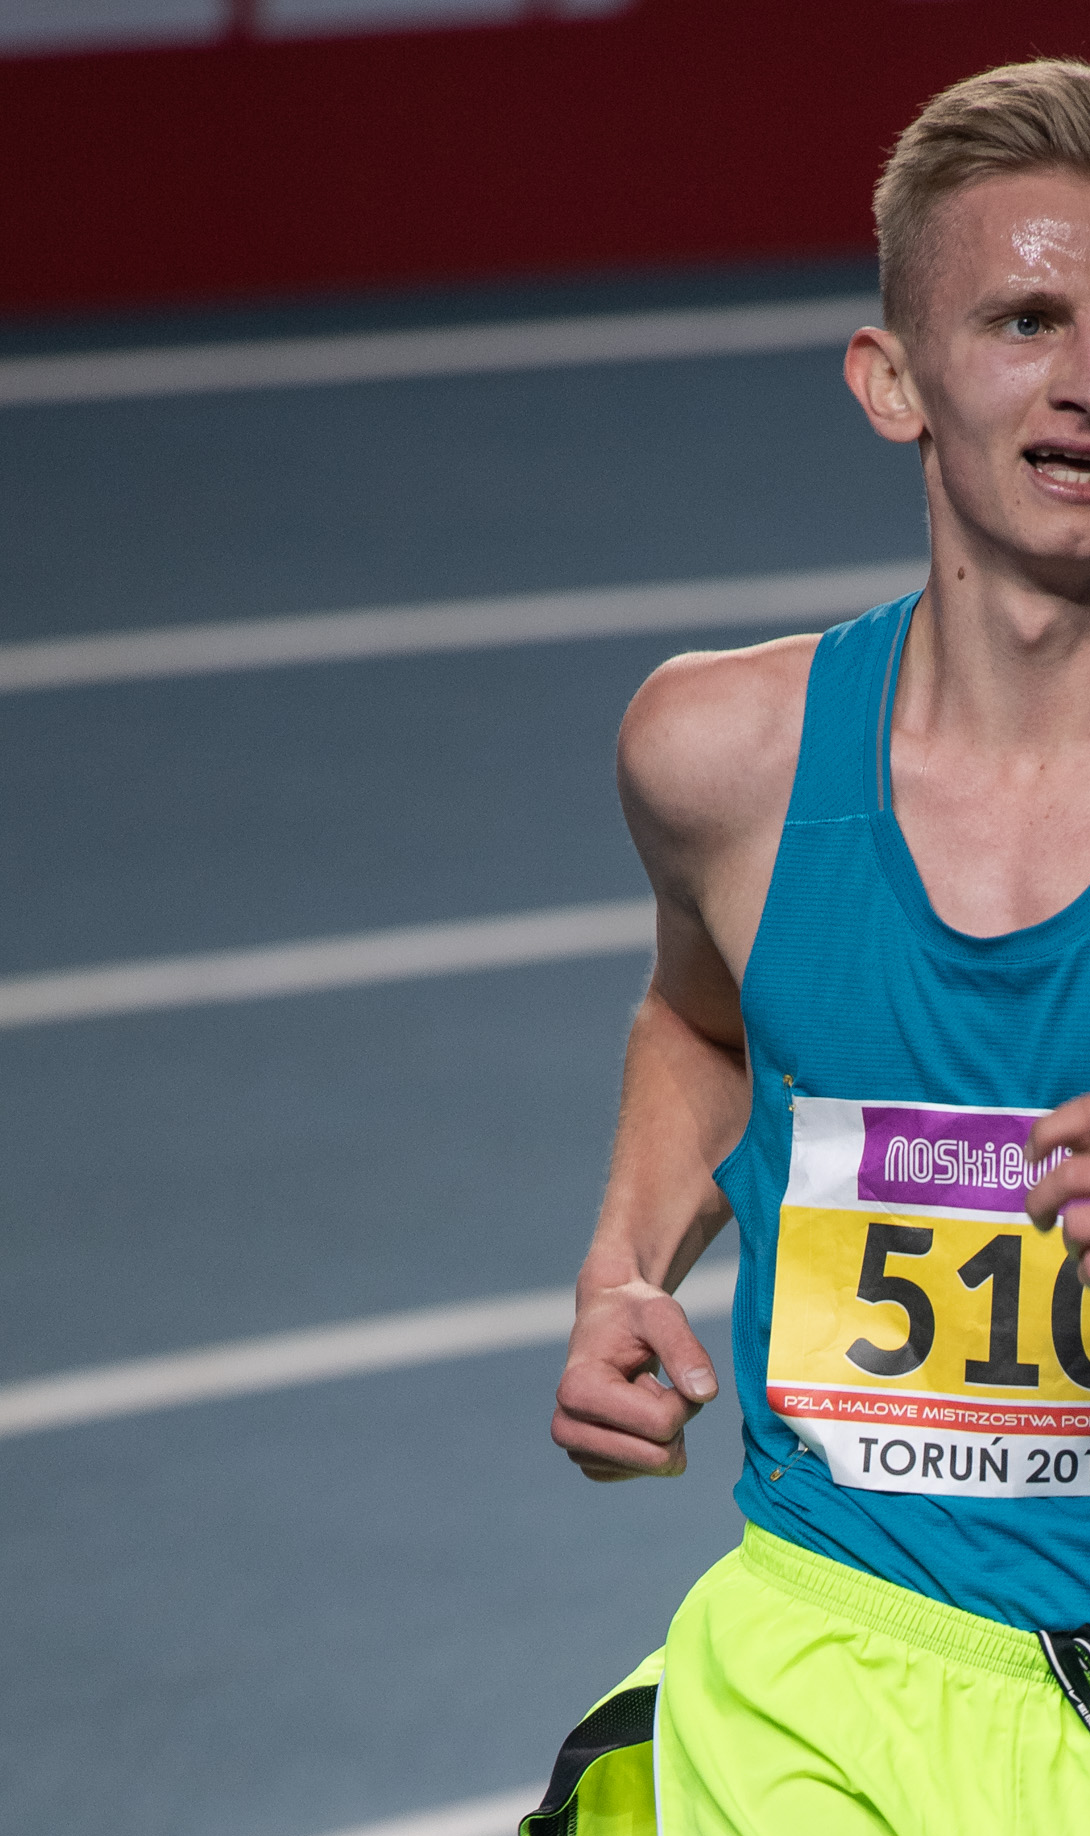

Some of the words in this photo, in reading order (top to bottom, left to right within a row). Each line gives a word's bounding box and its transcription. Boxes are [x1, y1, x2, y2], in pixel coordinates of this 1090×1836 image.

[784, 1395, 834, 1412] PZLA
[838, 1400, 918, 1418] HALOWE
[922, 1407, 1057, 1428] MISTRZOSTWA
[858, 1436, 1009, 1483] TORUŃ
